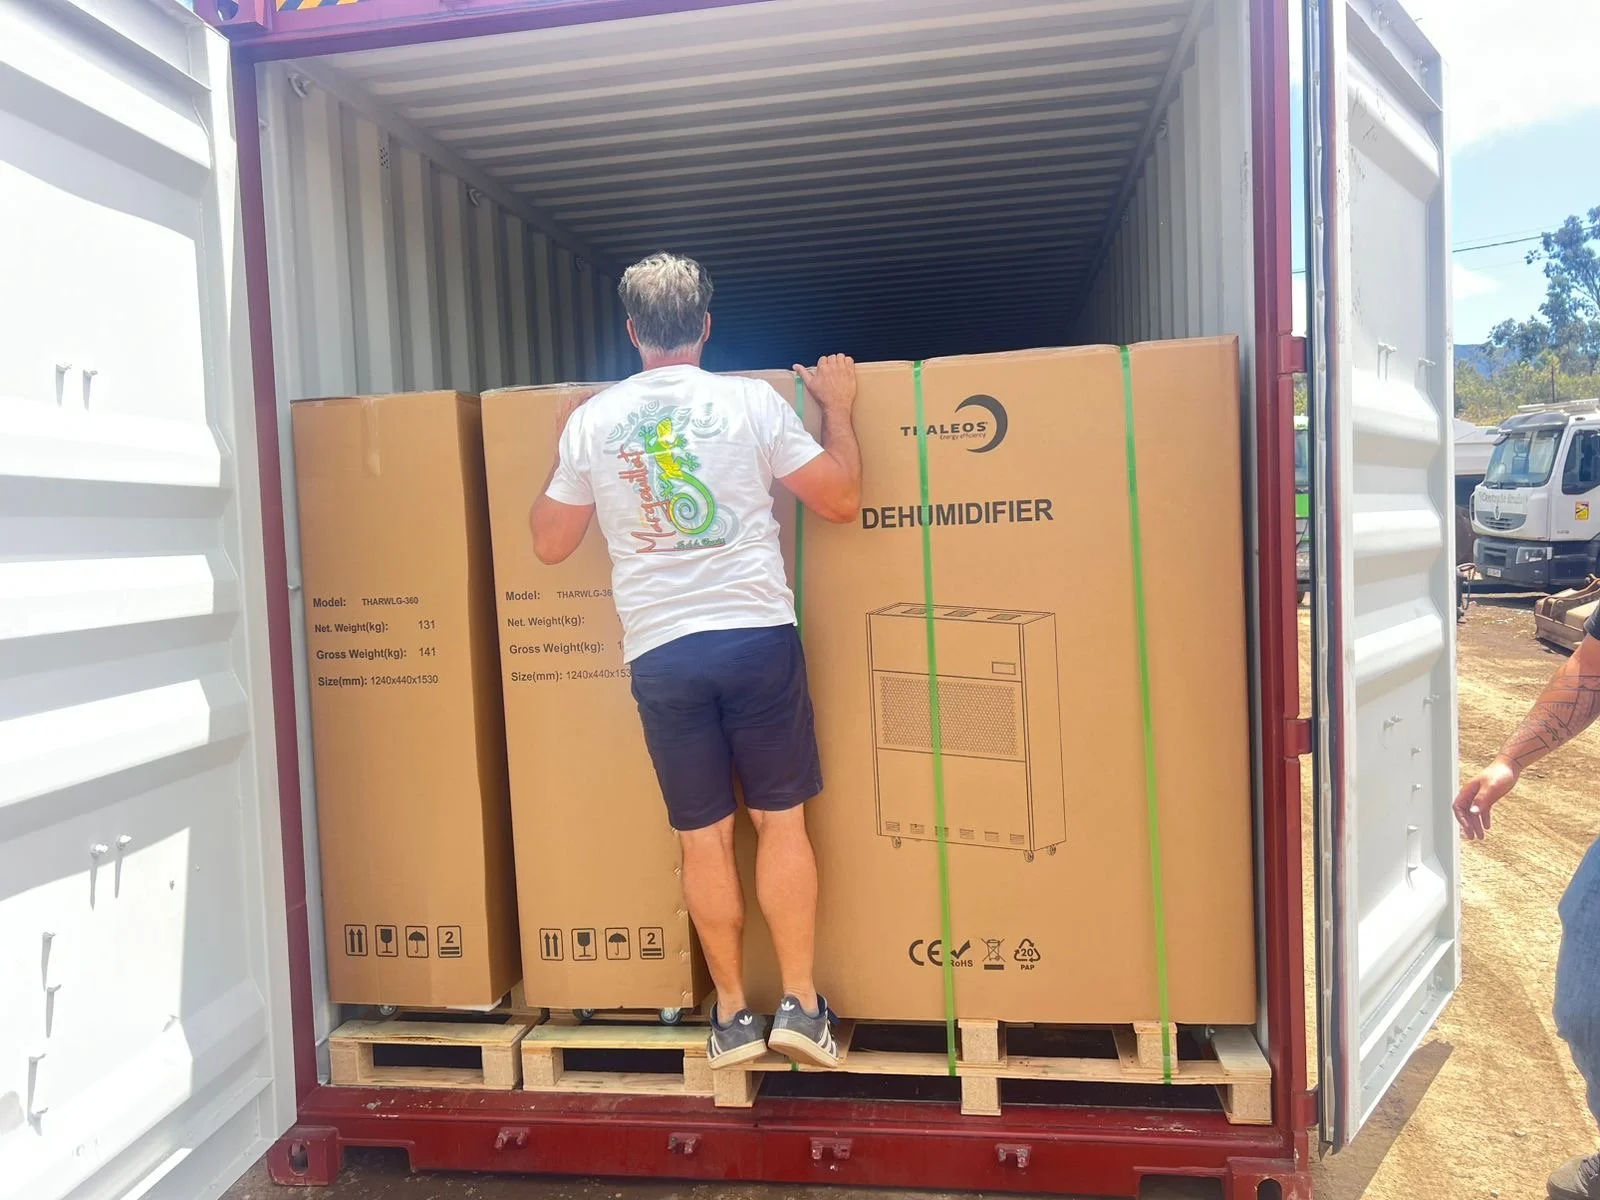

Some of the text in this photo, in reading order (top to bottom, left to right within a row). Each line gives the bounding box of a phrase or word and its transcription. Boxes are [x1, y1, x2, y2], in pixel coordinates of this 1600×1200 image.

[940, 432, 986, 441] Energy efficiency
[862, 498, 1054, 529] DEHUMIDIFIER
[506, 588, 612, 601] Model: THARWLG-36
[313, 596, 418, 608] Model: THARWLG-360
[314, 619, 435, 634] Net. Weight(kg): 131
[507, 614, 585, 628] Net. Weight(kg):
[316, 646, 436, 661] Gross Weight(kg): 141
[509, 643, 541, 654] Gross
[543, 641, 604, 655] Weight(kg):
[318, 674, 439, 688] Size(mm): 1240x440x1530
[511, 668, 632, 683] Size(mm): 1240x440x153
[444, 931, 455, 944] 2
[646, 932, 657, 945] 2
[908, 939, 943, 967] CE
[1020, 948, 1035, 958] 20
